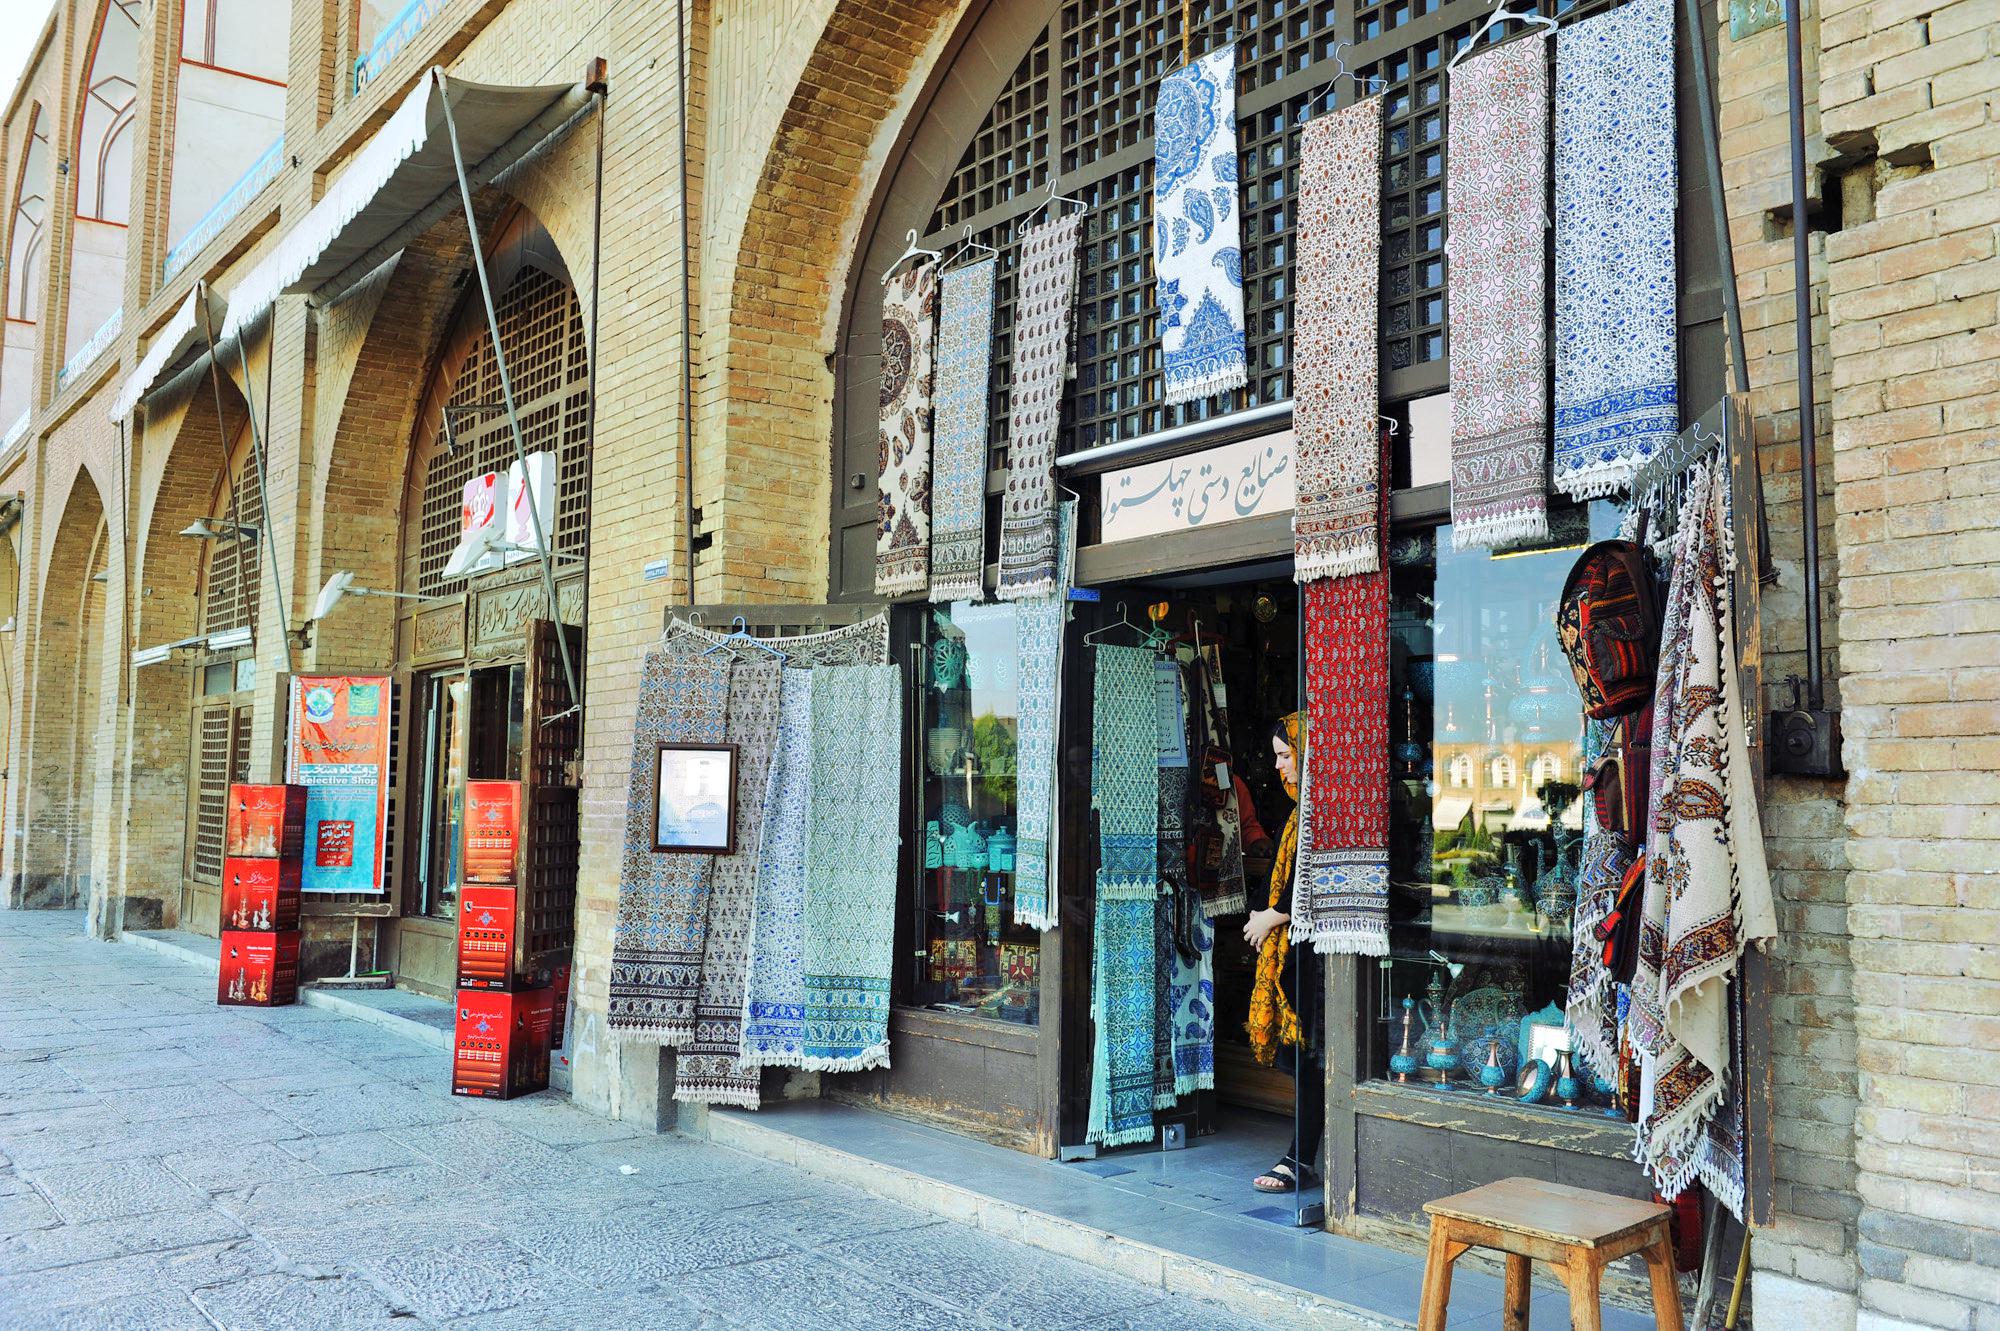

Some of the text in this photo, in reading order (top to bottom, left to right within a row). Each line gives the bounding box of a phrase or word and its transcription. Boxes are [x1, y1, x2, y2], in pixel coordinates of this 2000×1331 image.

[1234, 446, 1288, 516] صنایع
[1187, 463, 1230, 526] دستی
[293, 735, 300, 744] of
[299, 764, 378, 777] فروشگاه منتخب
[299, 776, 378, 786] Selective Shop
